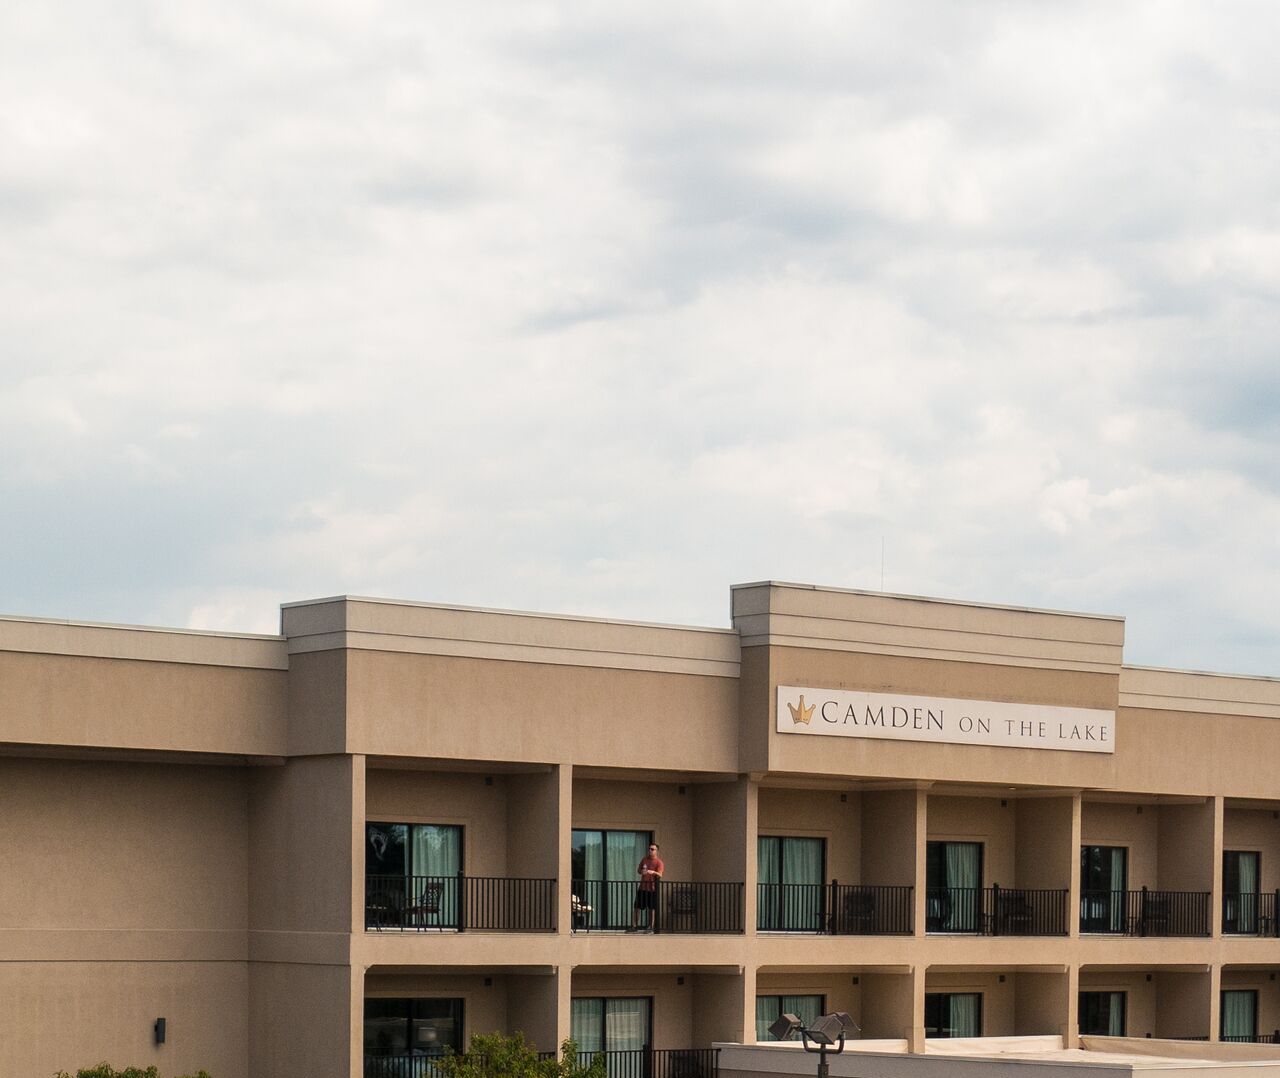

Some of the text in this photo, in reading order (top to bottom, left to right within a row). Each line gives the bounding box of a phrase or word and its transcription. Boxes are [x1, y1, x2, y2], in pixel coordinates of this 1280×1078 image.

[821, 701, 1108, 742] CAMDEN ON THE LAKE
